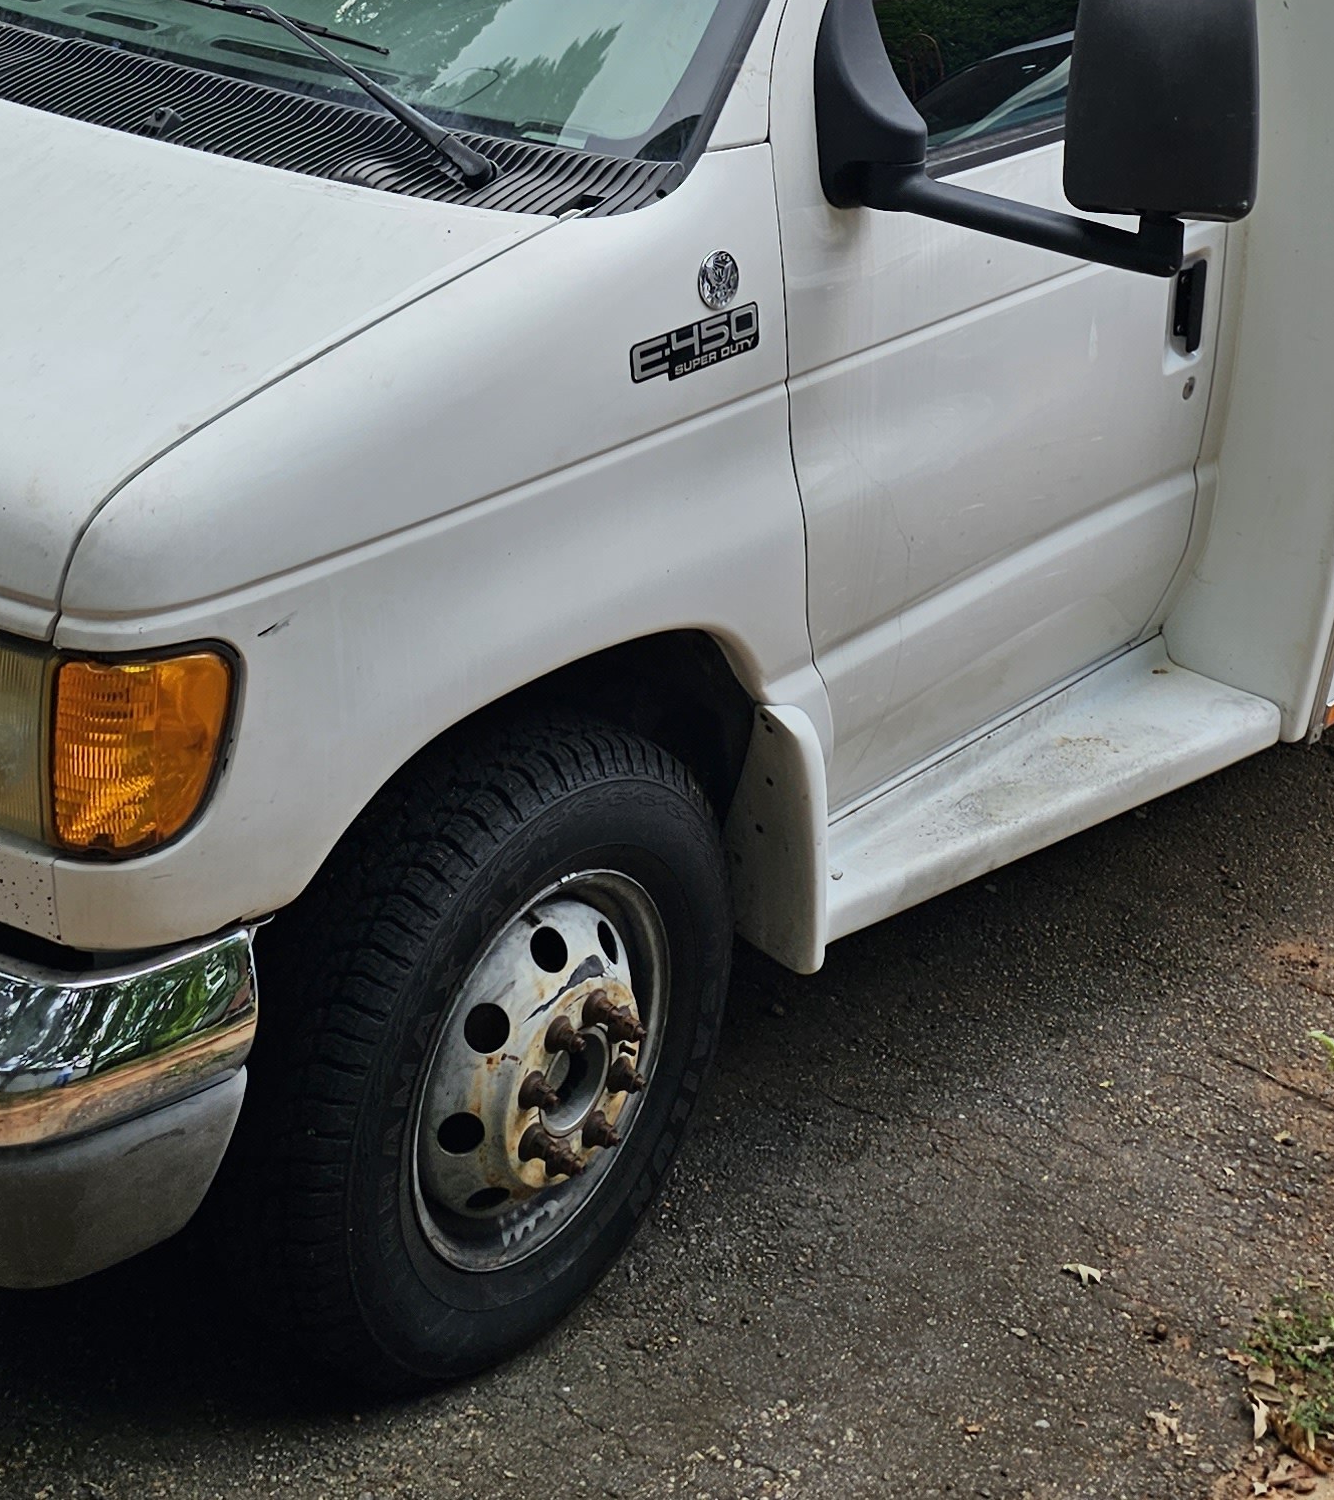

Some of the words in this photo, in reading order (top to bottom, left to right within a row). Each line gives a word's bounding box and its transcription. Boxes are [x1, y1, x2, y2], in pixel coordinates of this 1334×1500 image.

[632, 303, 758, 381] E-450
[675, 352, 717, 375] SUPER
[721, 337, 755, 358] DUTY
